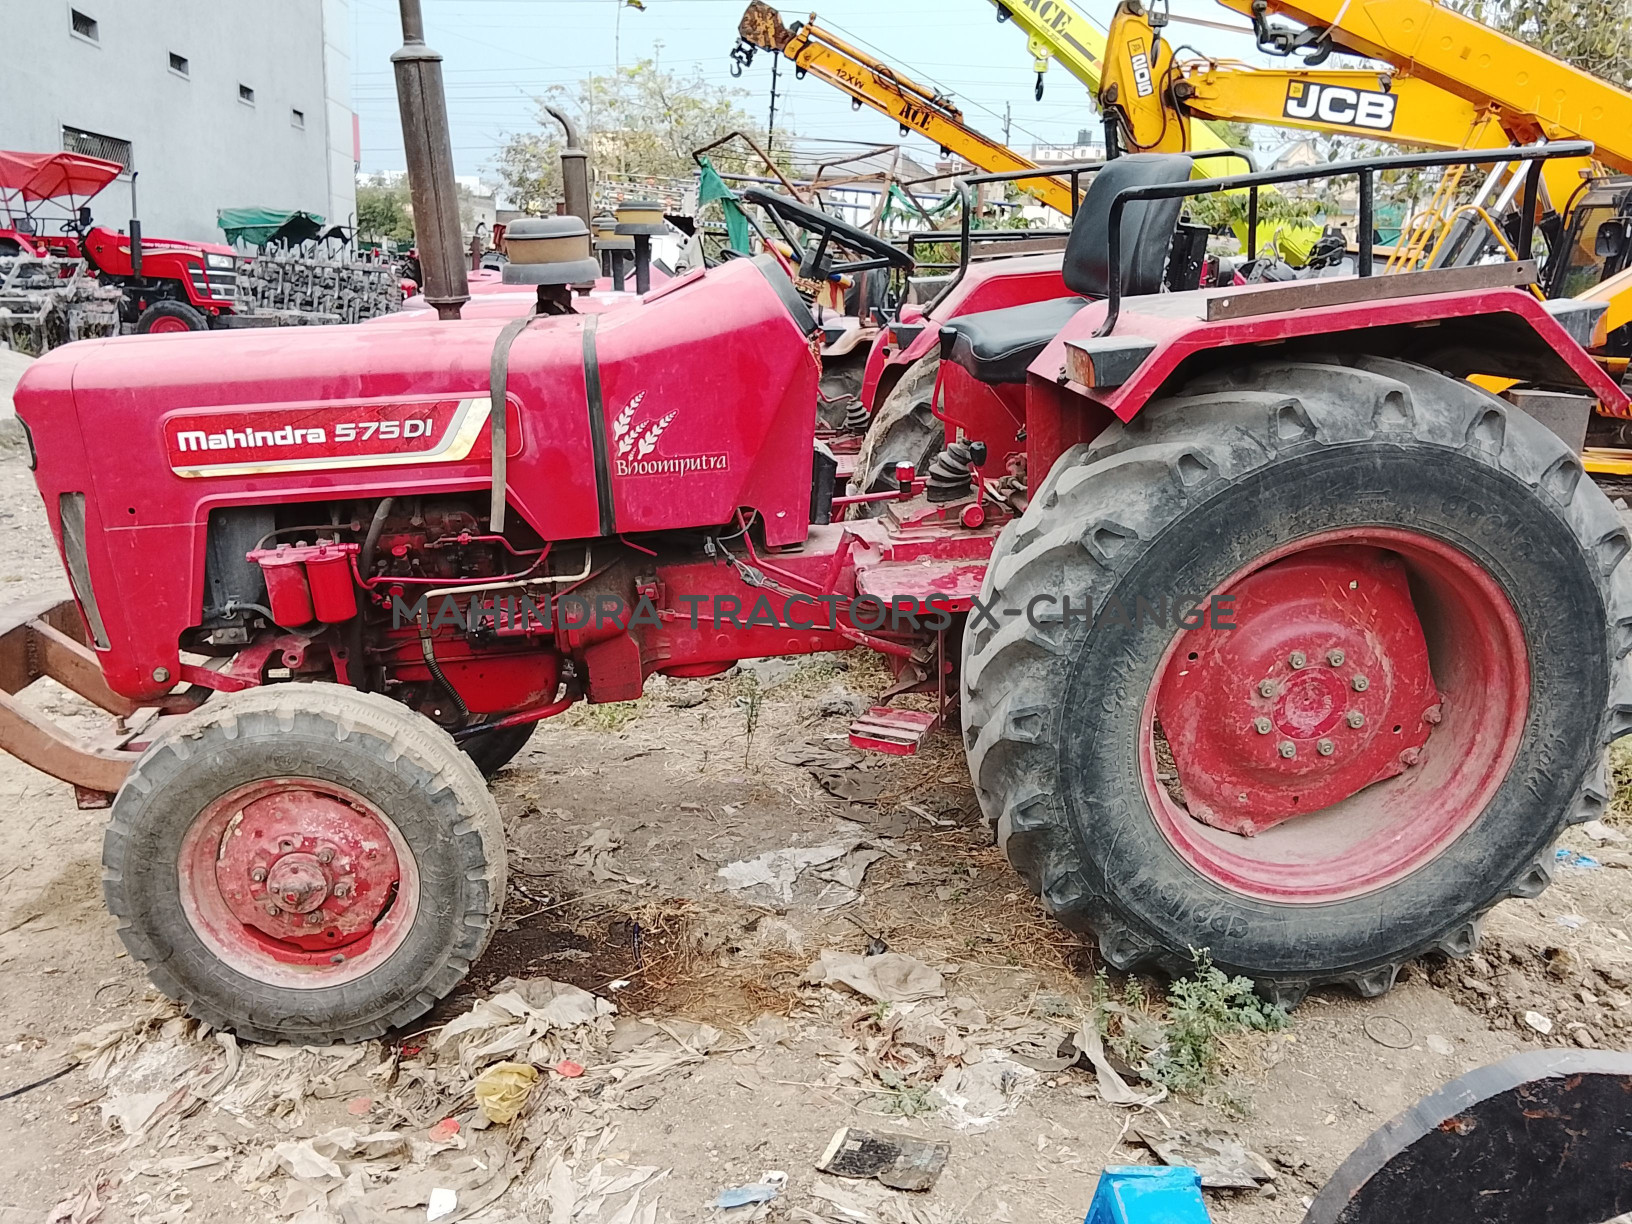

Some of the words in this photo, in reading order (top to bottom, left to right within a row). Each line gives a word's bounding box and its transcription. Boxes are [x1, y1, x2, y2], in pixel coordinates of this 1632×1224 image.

[836, 68, 865, 89] 12XW
[1131, 54, 1154, 96] 205
[898, 102, 935, 131] ACE
[1286, 85, 1395, 129] JCB
[176, 425, 326, 452] Mahindra
[615, 454, 727, 478] Bhoomiputra
